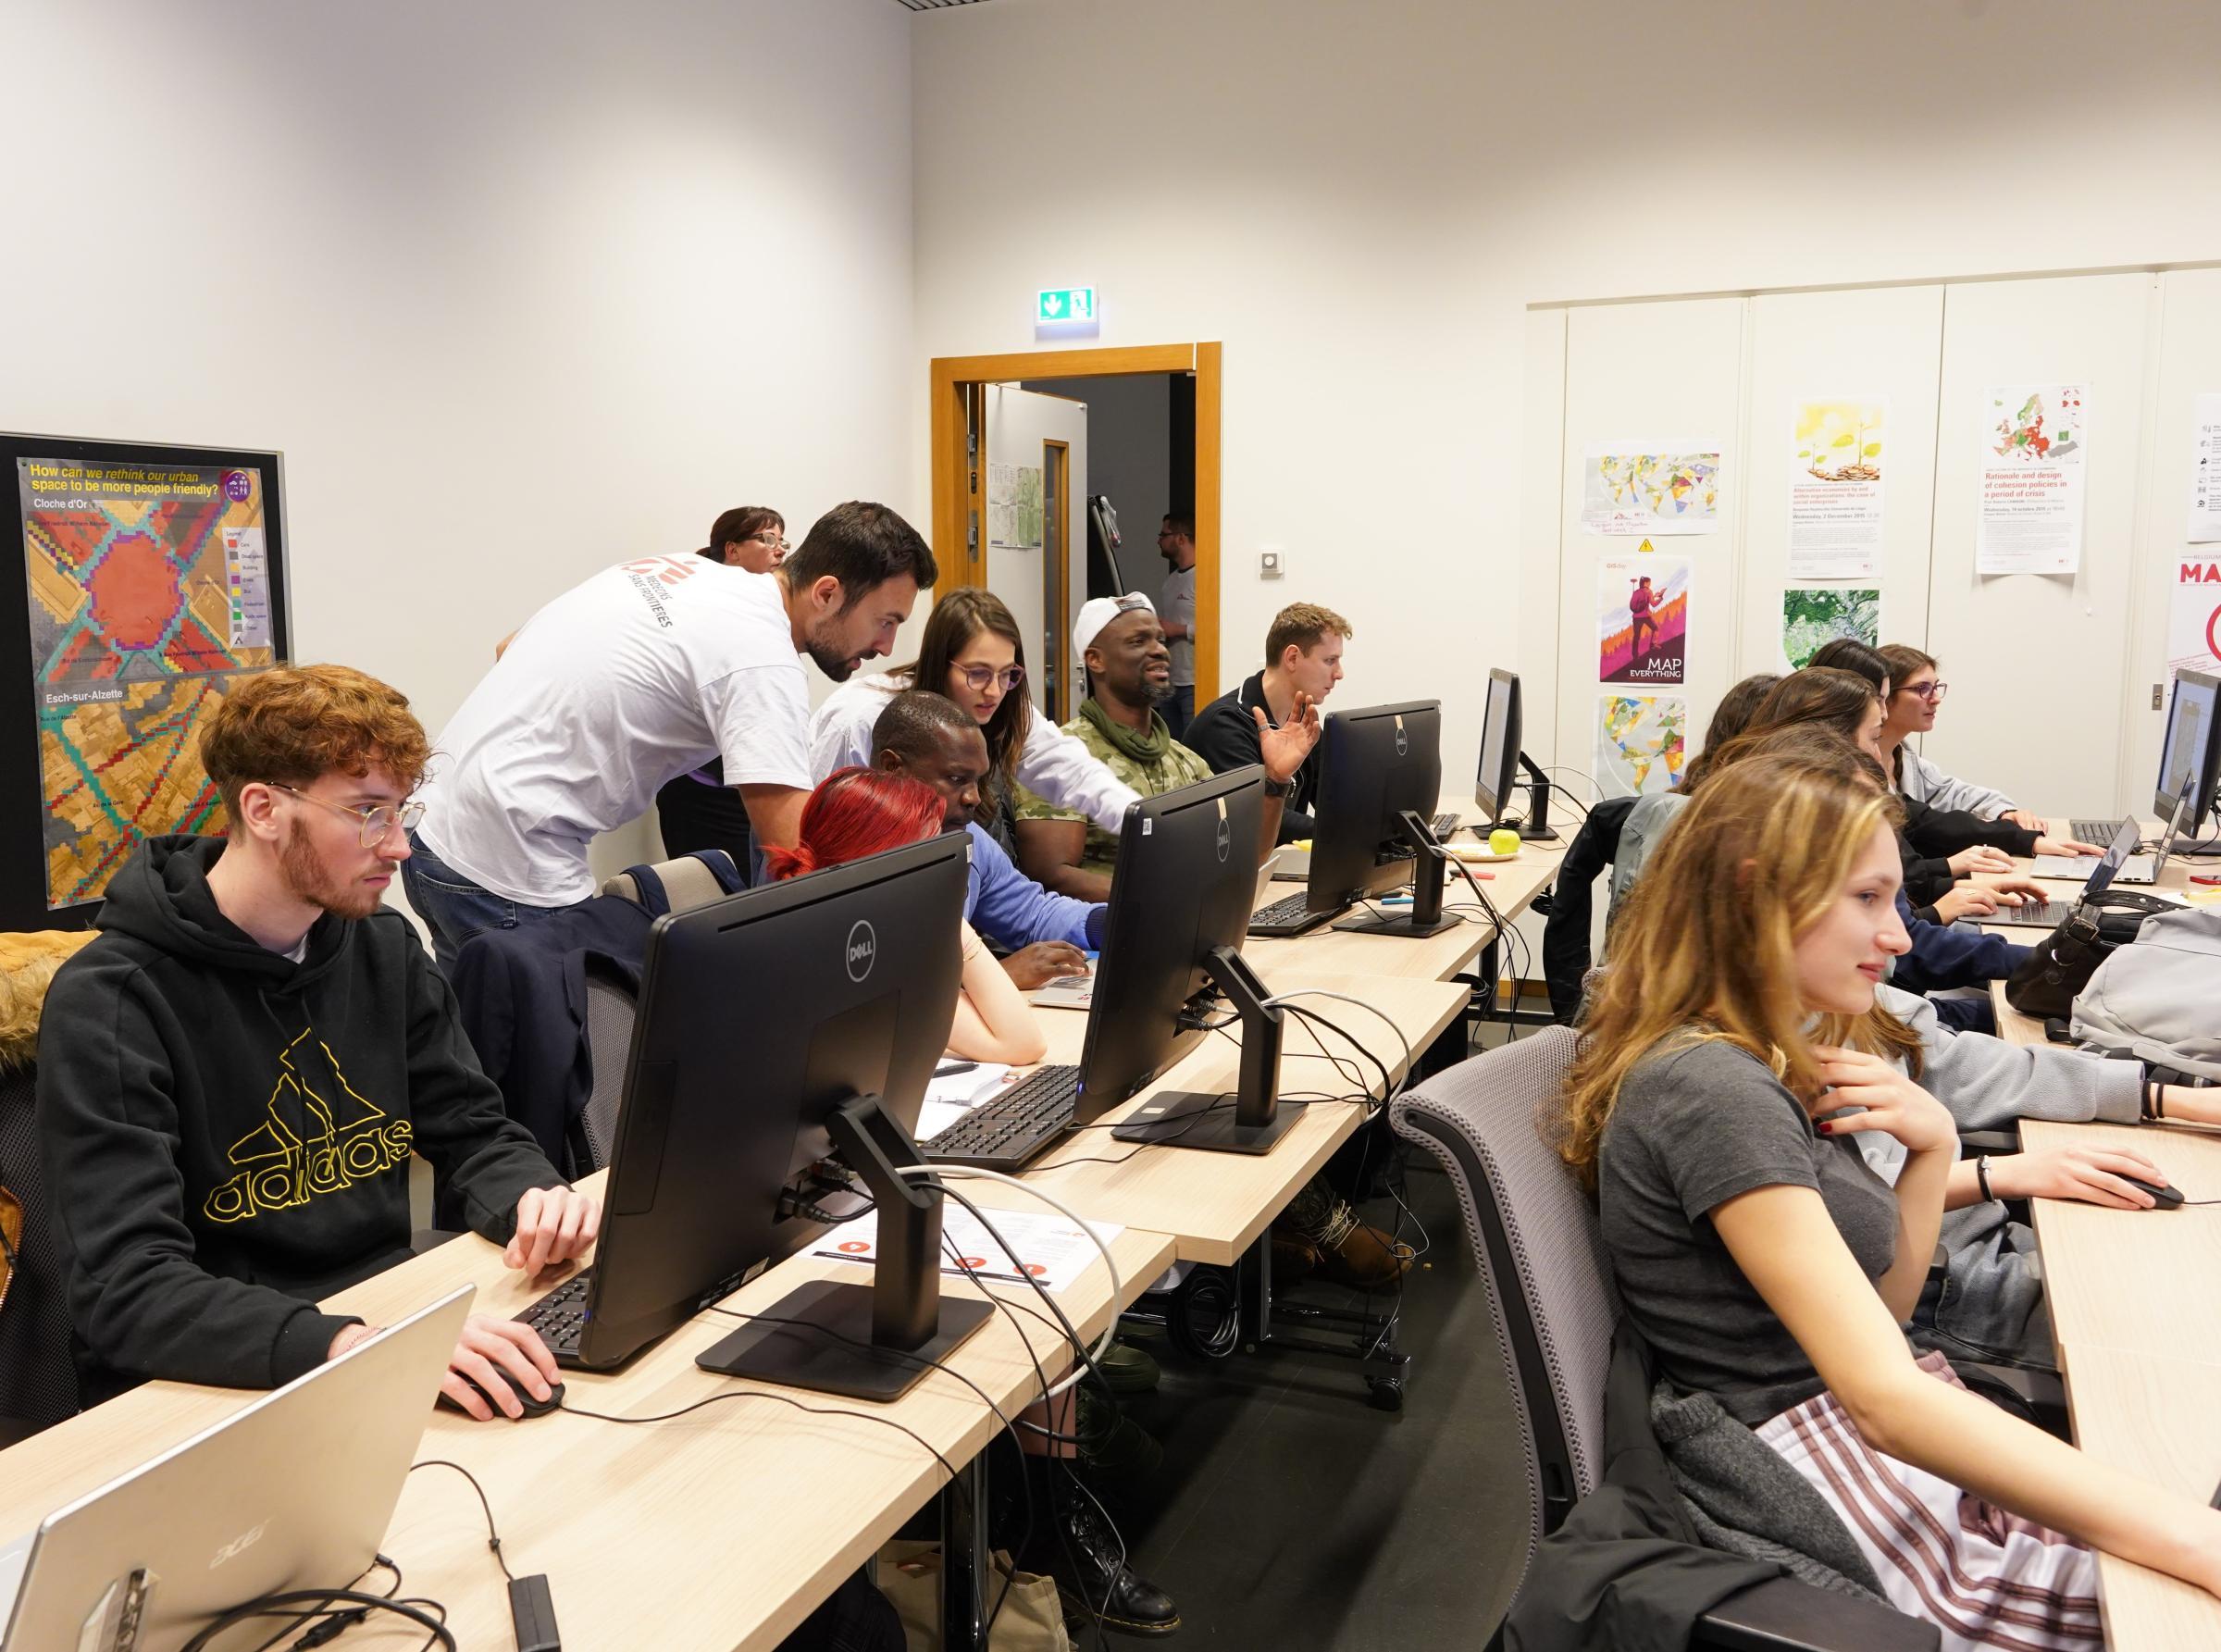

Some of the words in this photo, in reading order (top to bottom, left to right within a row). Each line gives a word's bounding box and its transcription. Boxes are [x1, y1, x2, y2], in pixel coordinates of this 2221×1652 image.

[30, 464, 58, 478] How
[62, 467, 82, 478] can
[86, 469, 103, 478] we
[106, 468, 145, 480] rethink
[148, 472, 166, 481] our
[169, 471, 199, 482] urban
[2037, 472, 2062, 481] design
[32, 480, 68, 493] space
[71, 480, 82, 491] to
[86, 480, 99, 492] be
[103, 482, 131, 492] more
[134, 483, 171, 496] people
[173, 483, 218, 497] friendly?
[2029, 480, 2058, 490] policies
[1991, 491, 2014, 500] period
[34, 498, 66, 509] Cloche
[68, 499, 87, 509] d'Or
[638, 587, 673, 628] FRONTIERES
[1647, 658, 1682, 671] MAP
[46, 689, 123, 703] Esch-sur-Alzette
[850, 941, 873, 962] DELL
[204, 1120, 413, 1223] adidas
[207, 1516, 275, 1571] acer
